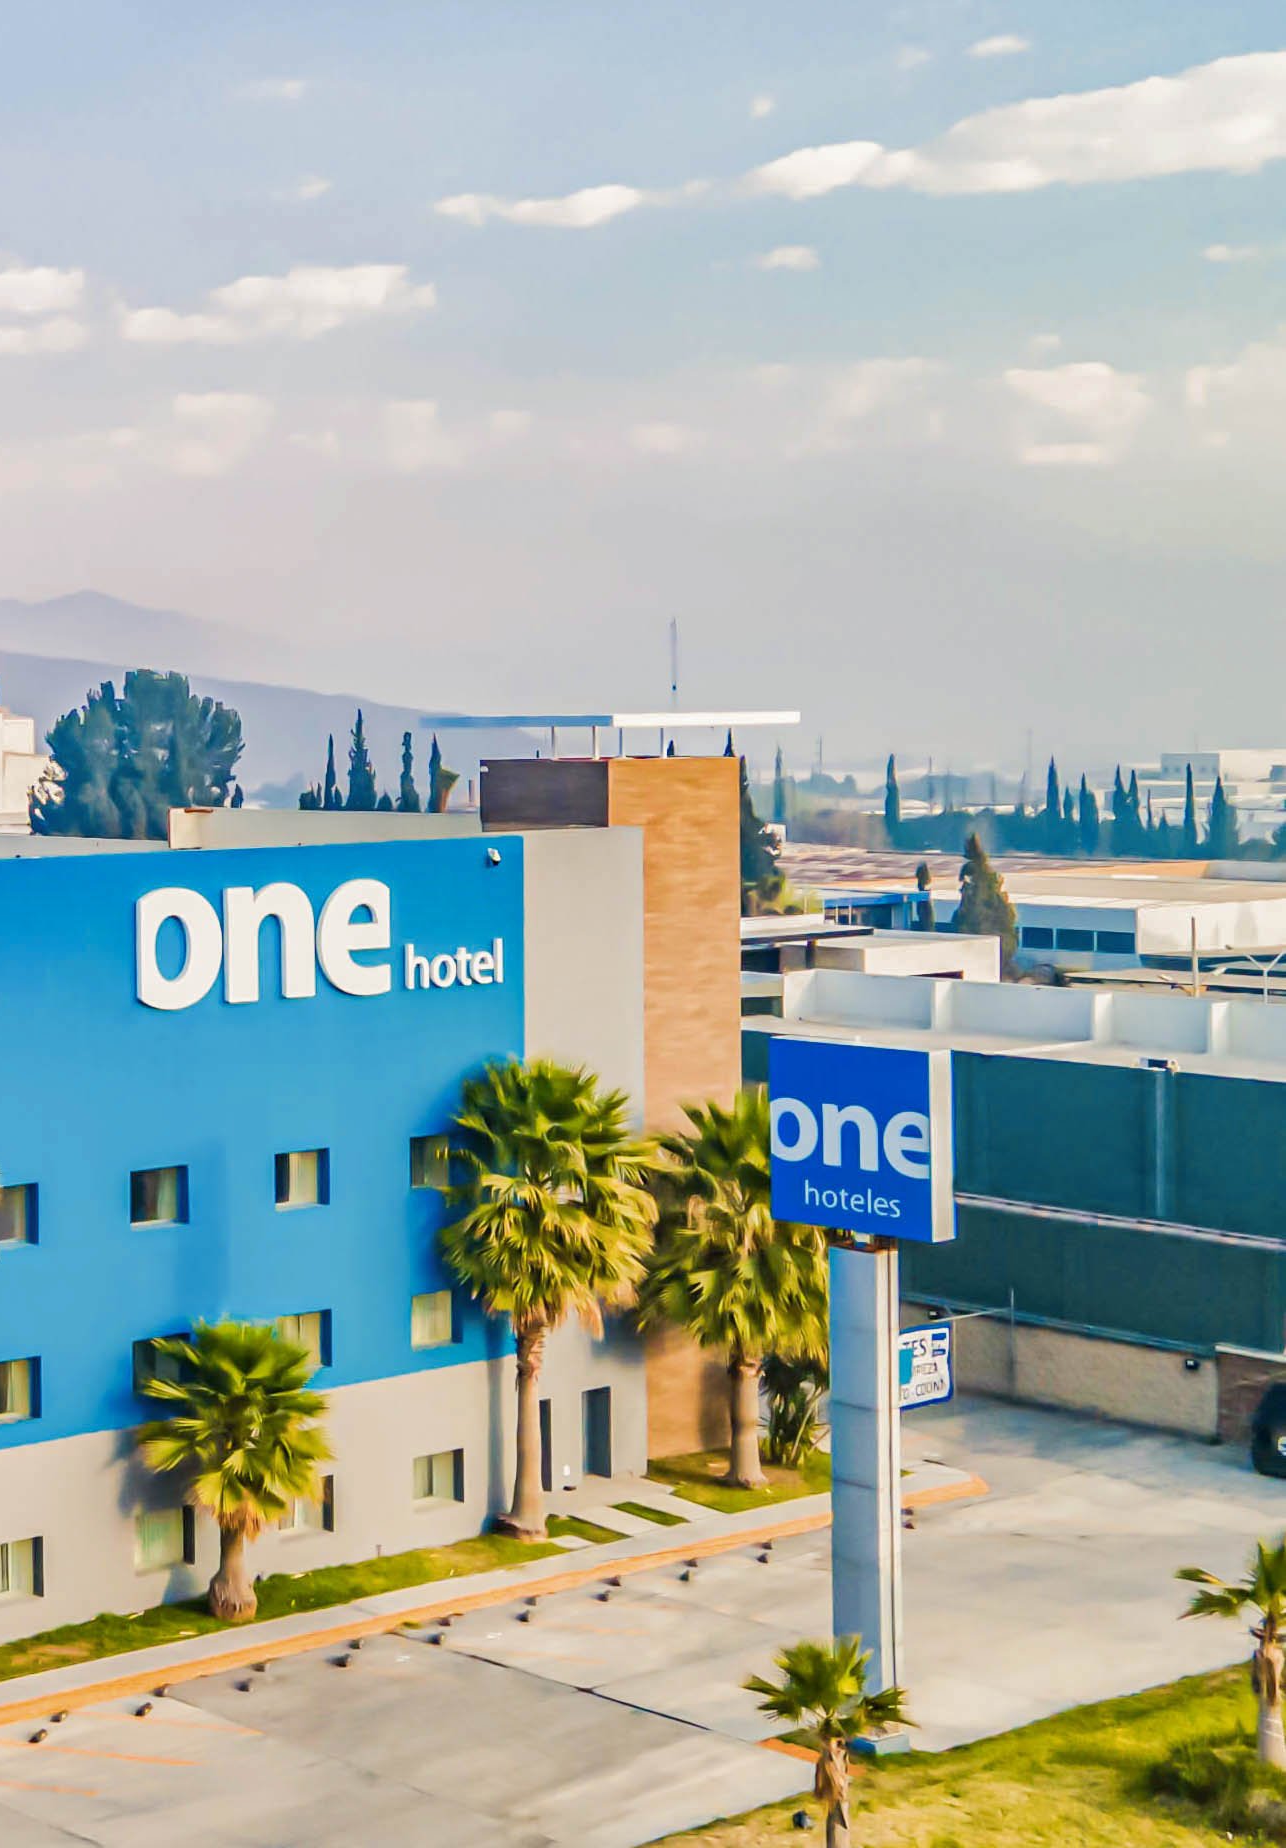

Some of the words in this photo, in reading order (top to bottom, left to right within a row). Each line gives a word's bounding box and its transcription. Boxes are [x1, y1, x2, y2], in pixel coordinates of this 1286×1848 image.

[136, 878, 391, 1010] one
[405, 938, 503, 990] hotel
[770, 1097, 930, 1180] one
[805, 1179, 901, 1218] hoteles
